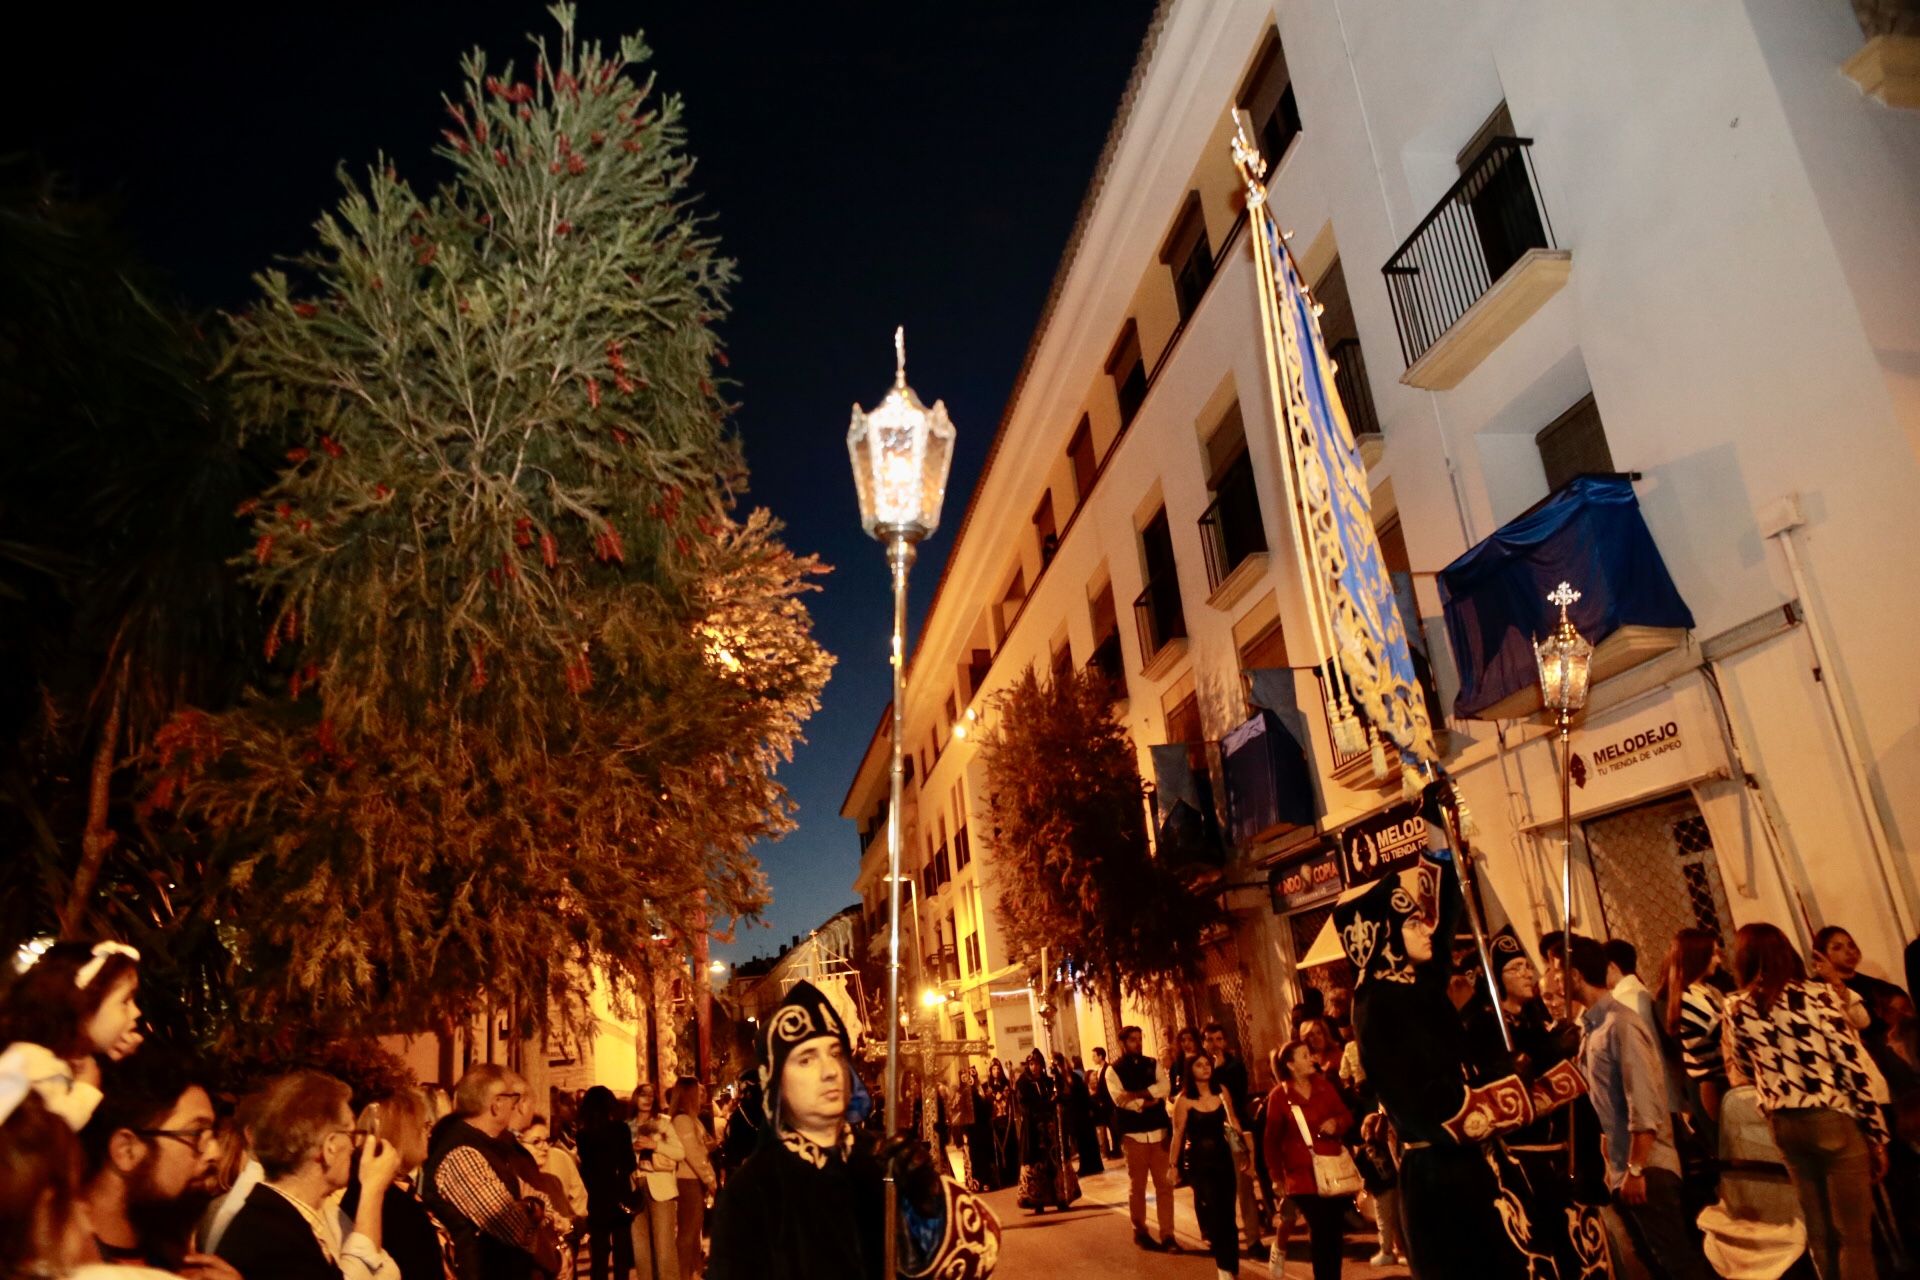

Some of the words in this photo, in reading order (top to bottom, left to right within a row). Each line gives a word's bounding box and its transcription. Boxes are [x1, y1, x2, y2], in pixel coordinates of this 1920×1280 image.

[1593, 721, 1678, 766] MELODEJO
[1597, 767, 1608, 776] TU
[1609, 756, 1638, 772] TIENDA
[1640, 751, 1651, 762] DE
[1653, 739, 1682, 756] VAPEO
[1380, 851, 1391, 863] TU
[1390, 842, 1418, 860] TIENDA
